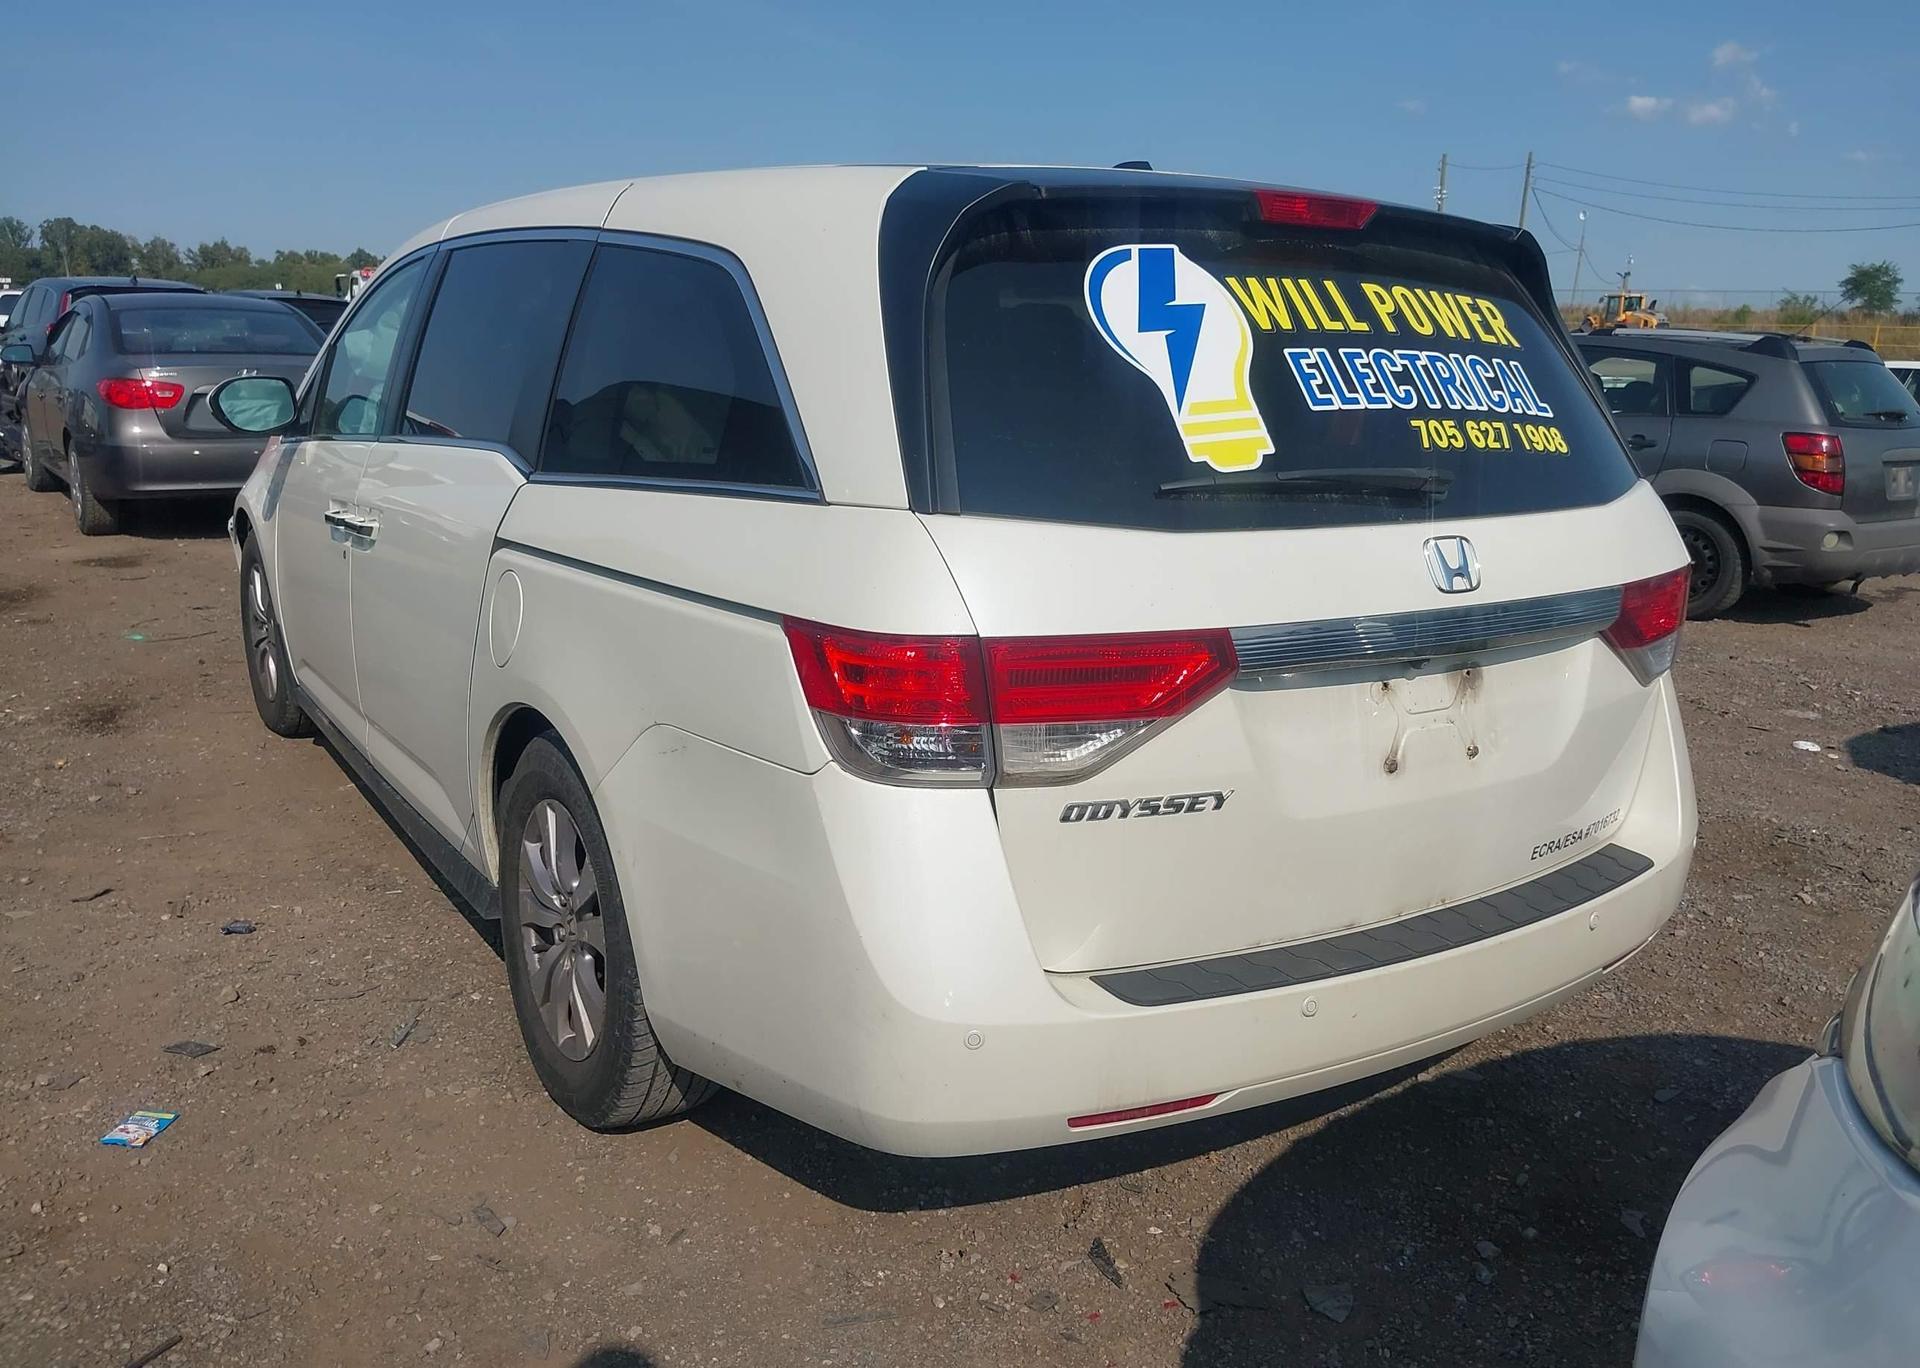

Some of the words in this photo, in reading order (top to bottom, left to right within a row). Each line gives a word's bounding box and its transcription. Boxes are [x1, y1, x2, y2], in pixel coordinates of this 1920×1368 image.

[1225, 277, 1371, 332] WILL
[1360, 282, 1521, 348] POWER
[1283, 348, 1554, 417] ELECTRICAL
[1410, 419, 1465, 450] 705
[1464, 420, 1510, 449] 627
[1512, 423, 1569, 455] 1908
[1059, 789, 1235, 823] ODYSSEY
[1530, 828, 1583, 860] ECRA/ESA
